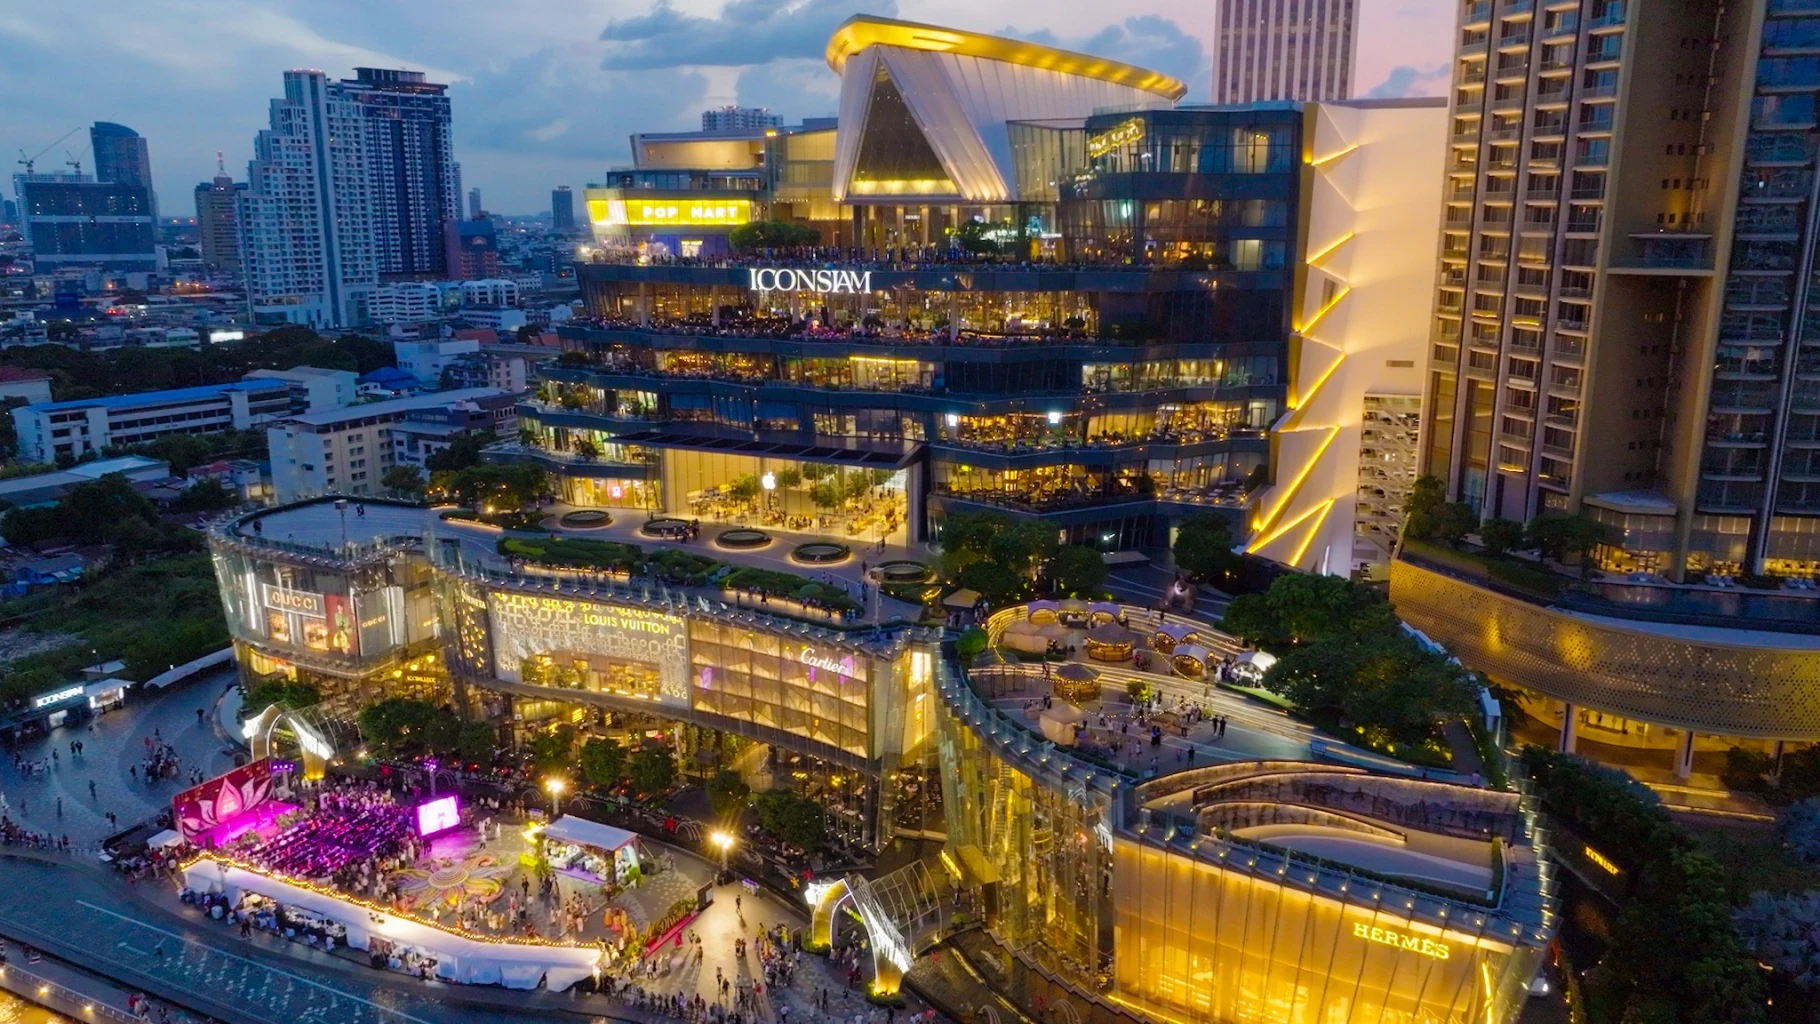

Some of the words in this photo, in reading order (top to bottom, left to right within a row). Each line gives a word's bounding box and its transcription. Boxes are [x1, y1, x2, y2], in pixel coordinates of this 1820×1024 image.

[642, 205, 679, 219] POP
[690, 205, 739, 219] MART
[749, 268, 872, 294] ICONSIAM
[271, 590, 318, 612] GUCCI
[584, 613, 618, 628] LOUIS
[620, 618, 670, 635] VUITTON
[801, 647, 848, 674] Cartier
